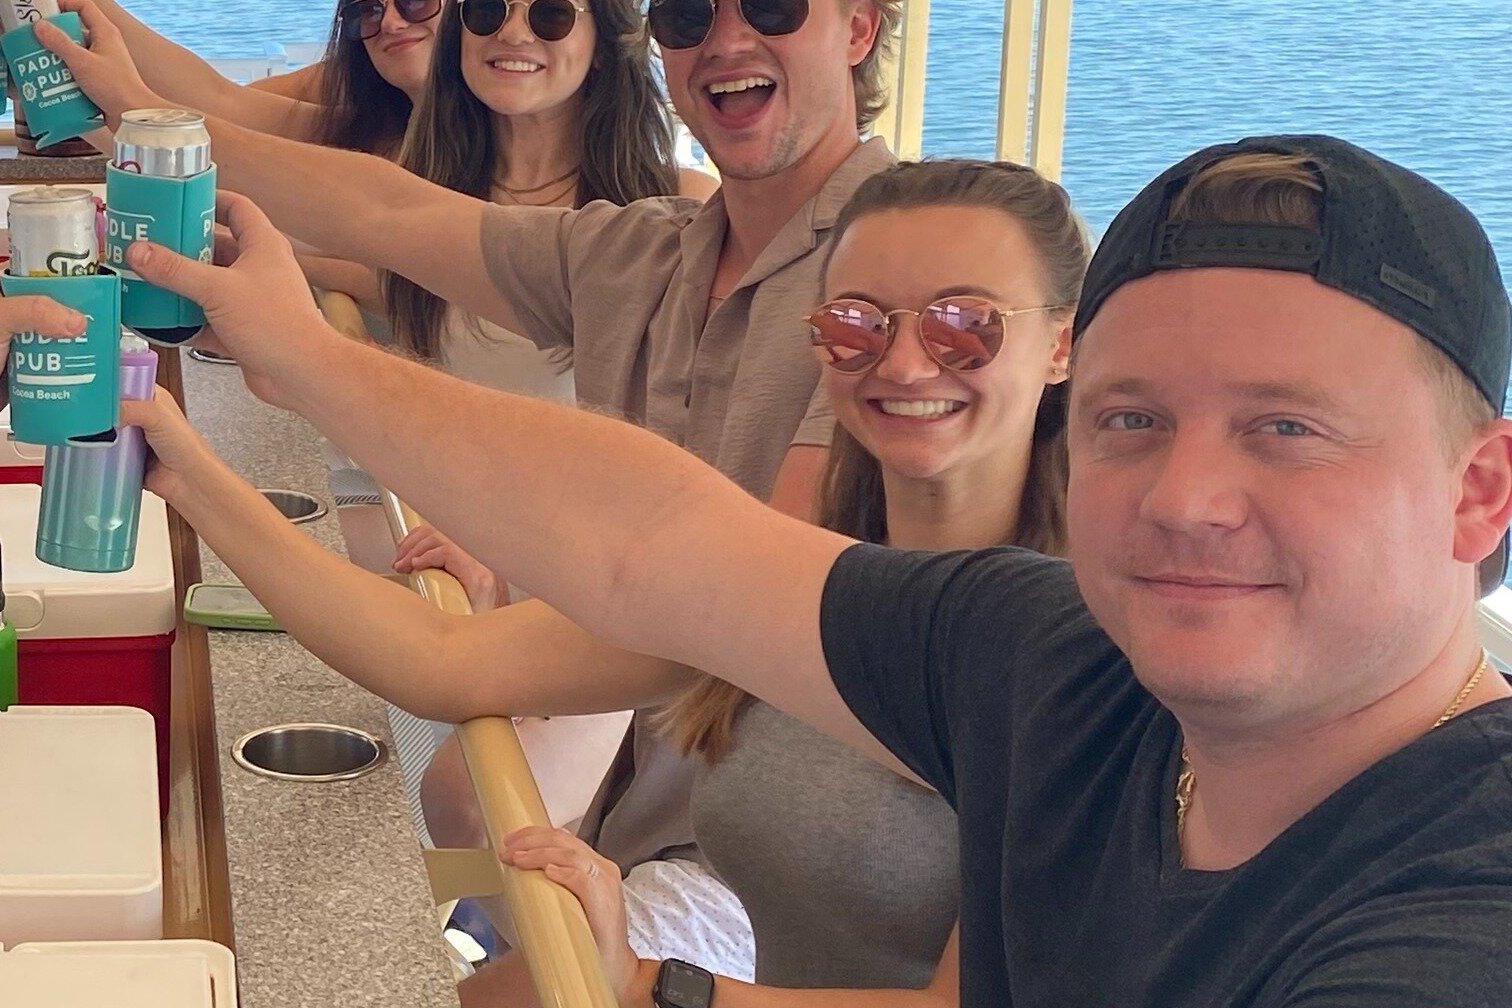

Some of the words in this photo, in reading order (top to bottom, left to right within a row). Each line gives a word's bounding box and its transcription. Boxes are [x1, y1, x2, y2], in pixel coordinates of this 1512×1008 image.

[17, 54, 62, 77] PADD
[109, 218, 148, 241] DLE
[15, 352, 62, 371] PUB
[12, 386, 35, 399] Cocoa
[36, 389, 71, 400] Beach
